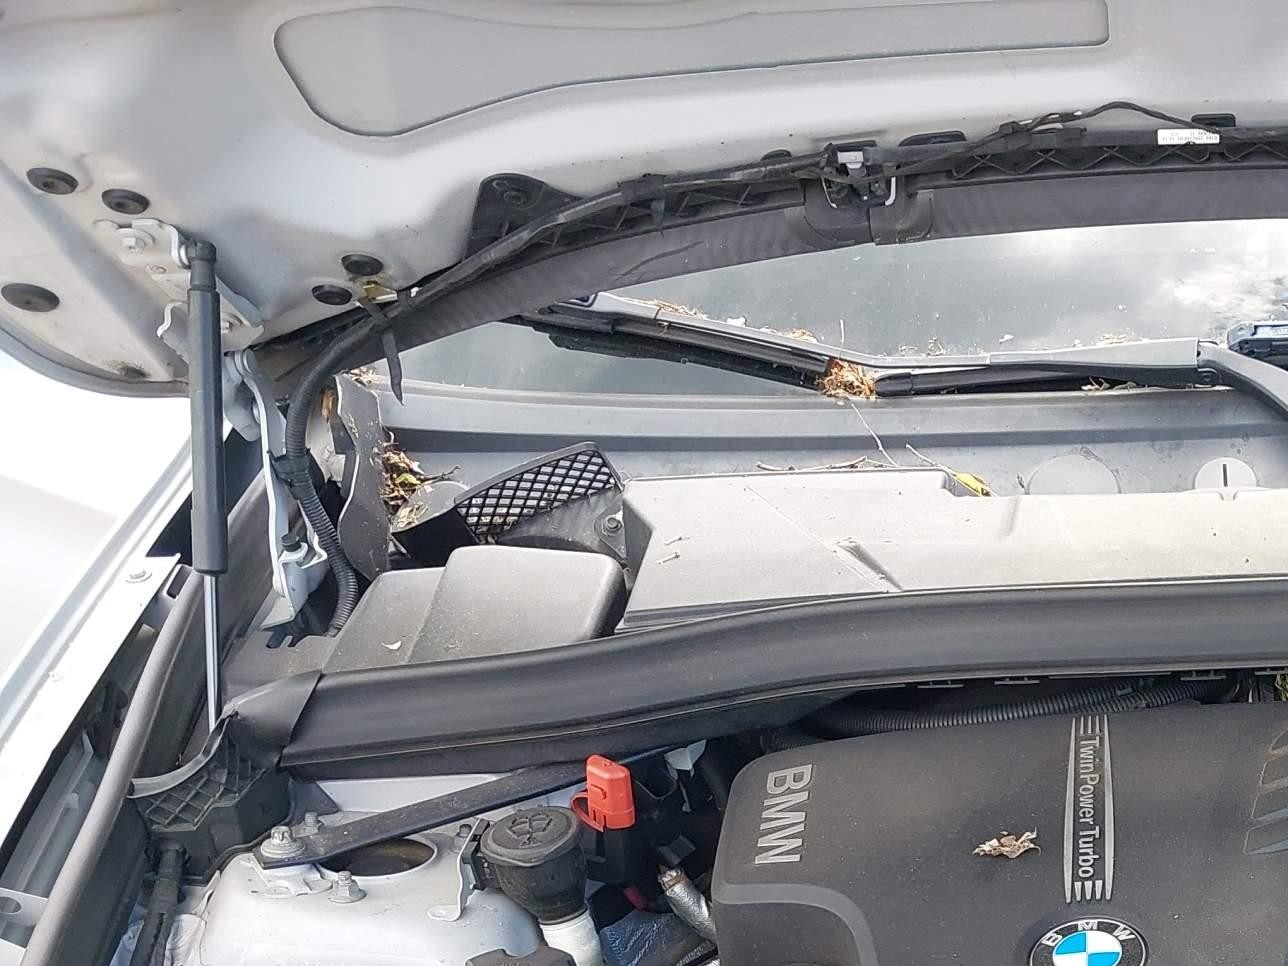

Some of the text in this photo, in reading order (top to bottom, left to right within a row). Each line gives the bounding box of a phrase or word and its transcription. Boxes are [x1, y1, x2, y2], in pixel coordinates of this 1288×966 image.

[754, 764, 812, 865] BMW
[1078, 825, 1100, 878] Turbo
[1041, 920, 1136, 947] BMW
